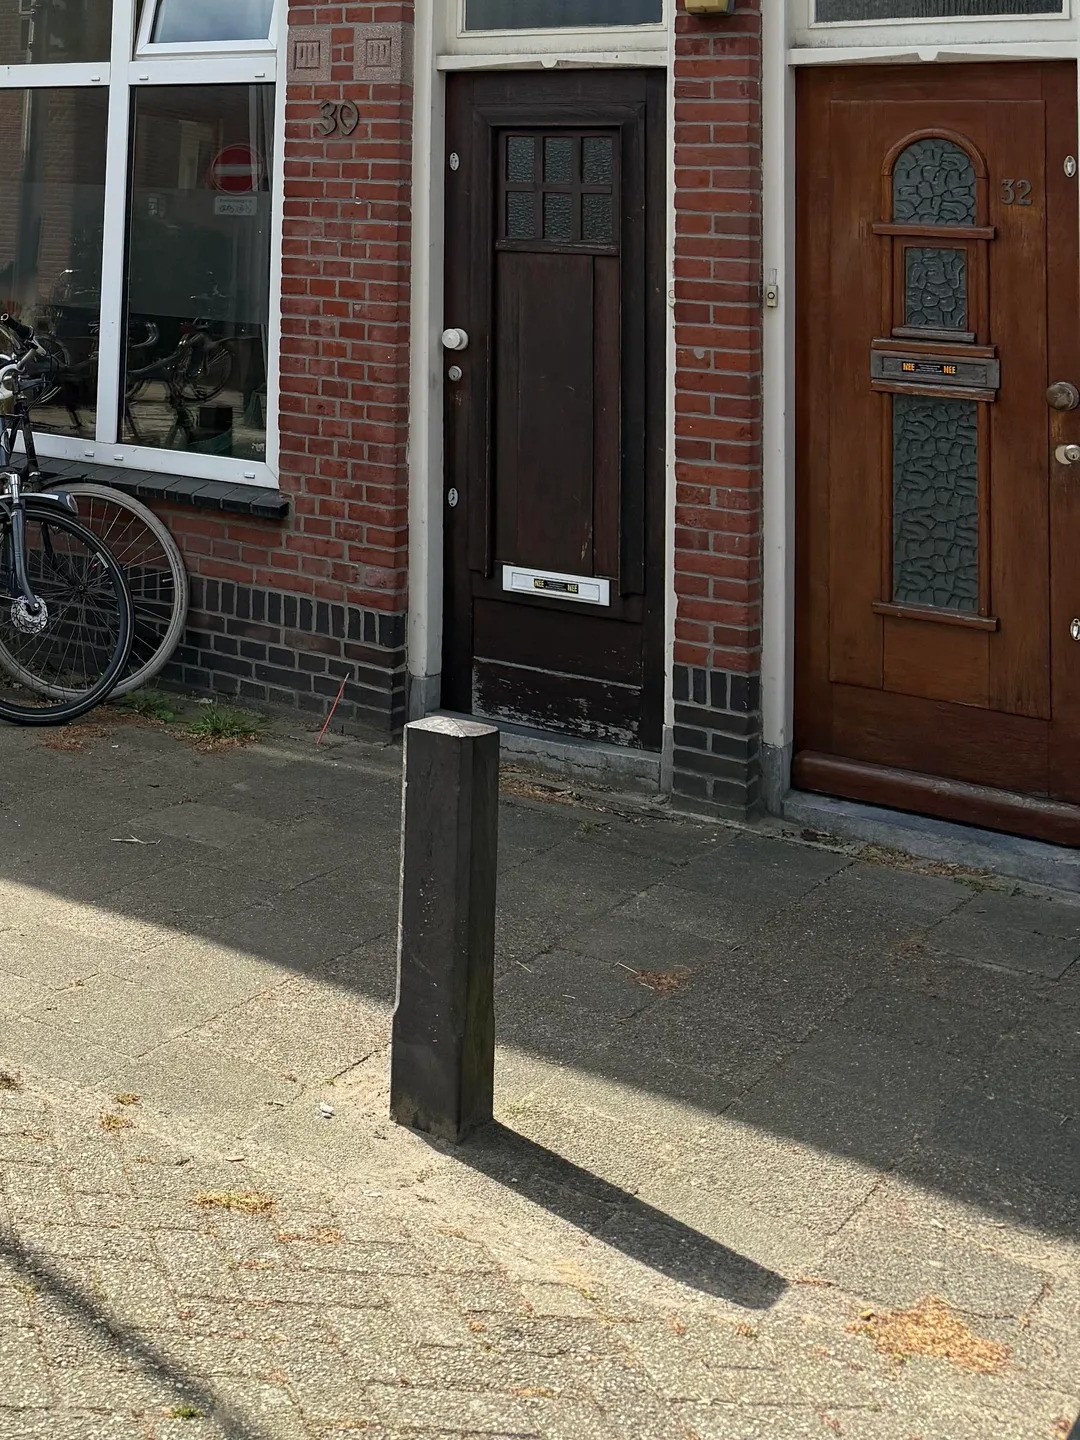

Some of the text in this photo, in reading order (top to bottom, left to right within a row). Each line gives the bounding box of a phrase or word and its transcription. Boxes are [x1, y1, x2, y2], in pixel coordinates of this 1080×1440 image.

[318, 99, 360, 136] 30
[1000, 178, 1034, 206] 32
[902, 362, 915, 372] NEE
[943, 365, 956, 374] NEE
[534, 579, 545, 588] NEE
[567, 584, 578, 593] NEE
